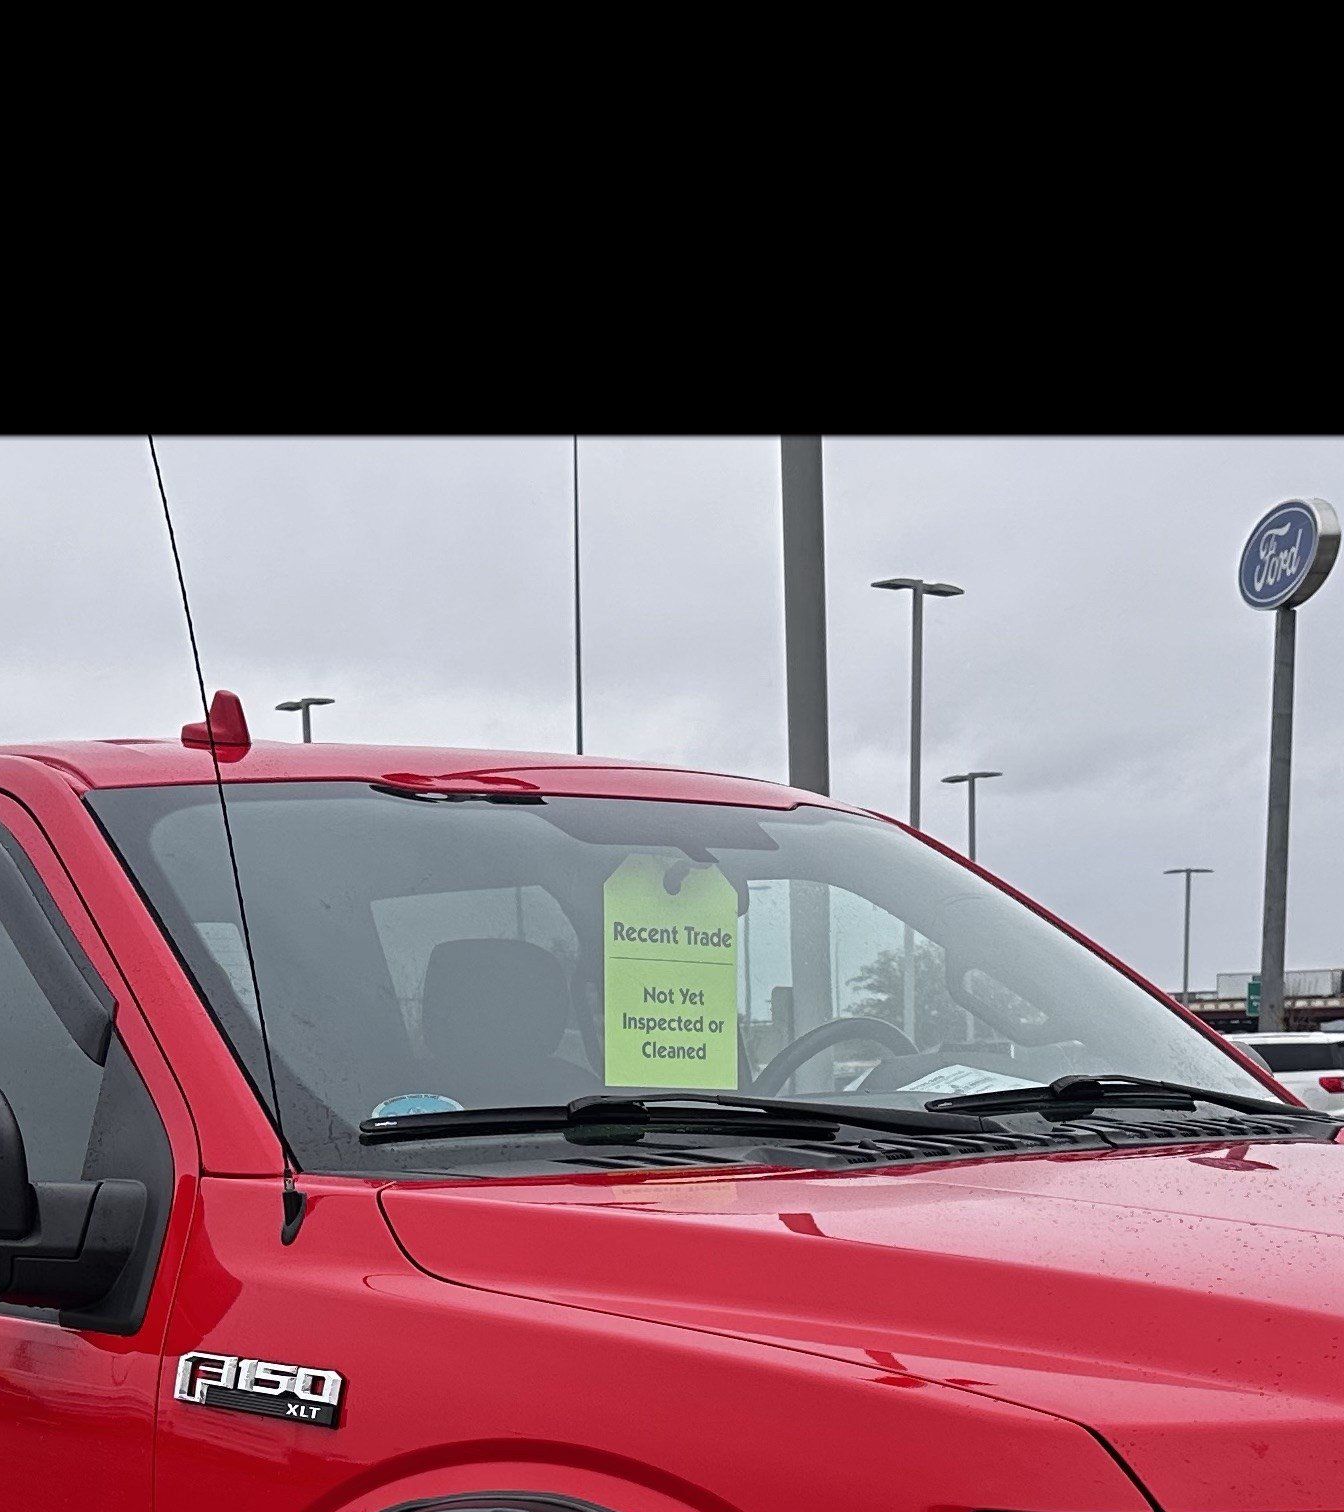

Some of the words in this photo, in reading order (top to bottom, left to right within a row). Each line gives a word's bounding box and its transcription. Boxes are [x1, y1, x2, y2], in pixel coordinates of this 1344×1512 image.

[1254, 522, 1305, 592] Ford
[613, 921, 679, 945] Recent
[684, 926, 733, 948] Trade
[643, 986, 674, 1005] Not
[679, 988, 705, 1006] Yet
[623, 1012, 704, 1034] Inspected
[708, 1020, 725, 1033] or
[642, 1041, 706, 1060] Cleaned
[286, 1403, 321, 1419] XLT
